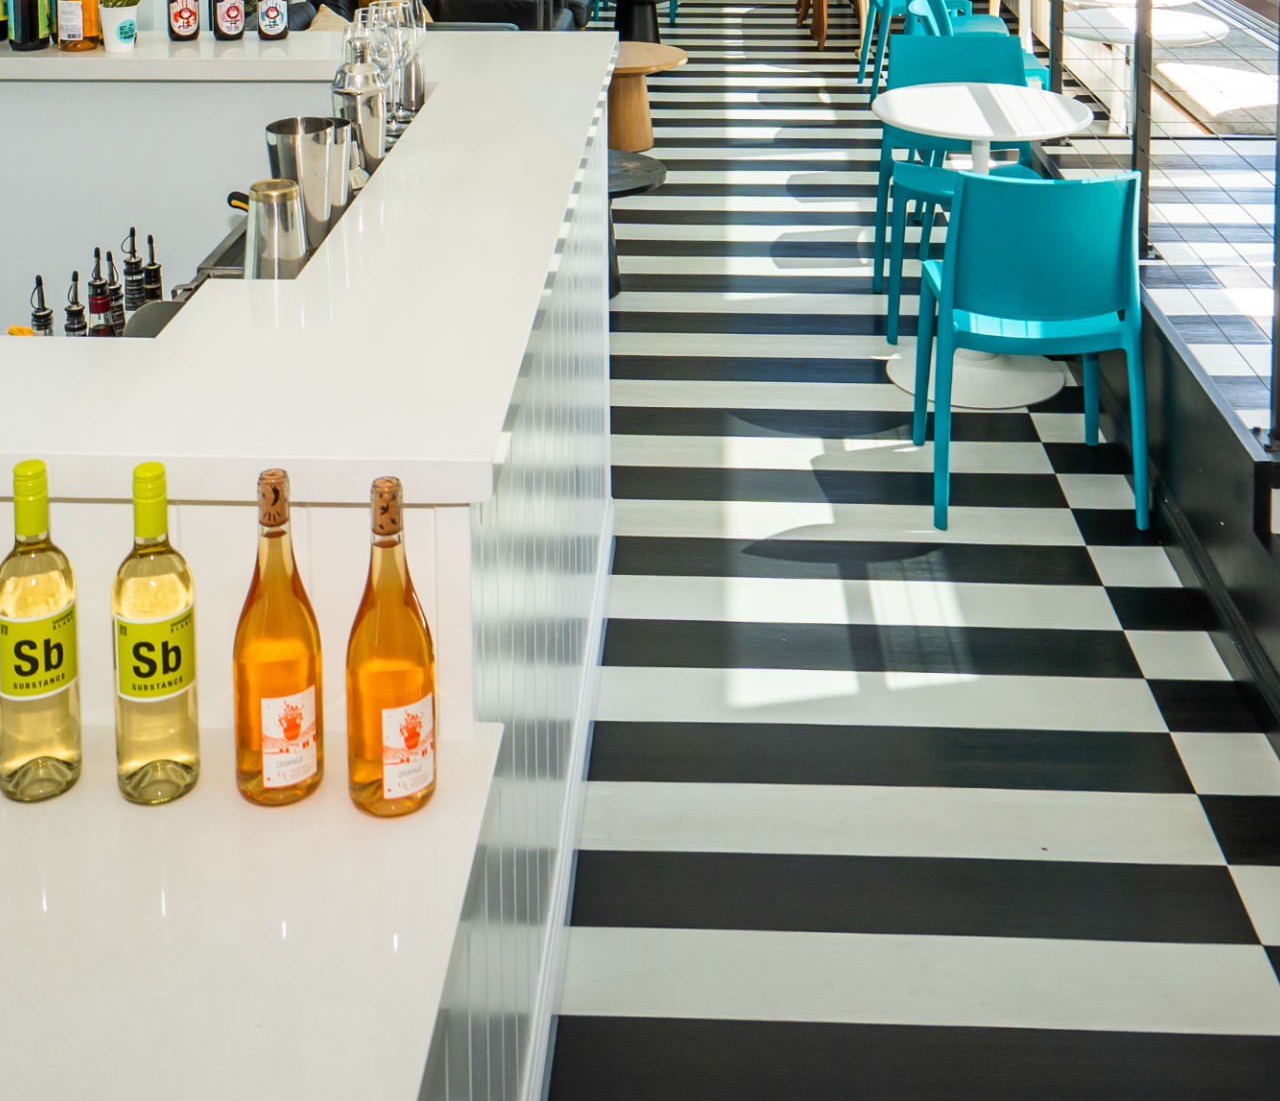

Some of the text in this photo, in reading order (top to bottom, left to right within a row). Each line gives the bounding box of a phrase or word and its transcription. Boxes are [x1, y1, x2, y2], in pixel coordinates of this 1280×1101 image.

[14, 638, 63, 677] Sb
[132, 640, 181, 678] Sb
[13, 672, 65, 690] SUBSTANCE
[132, 675, 183, 691] SUBSTANCE
